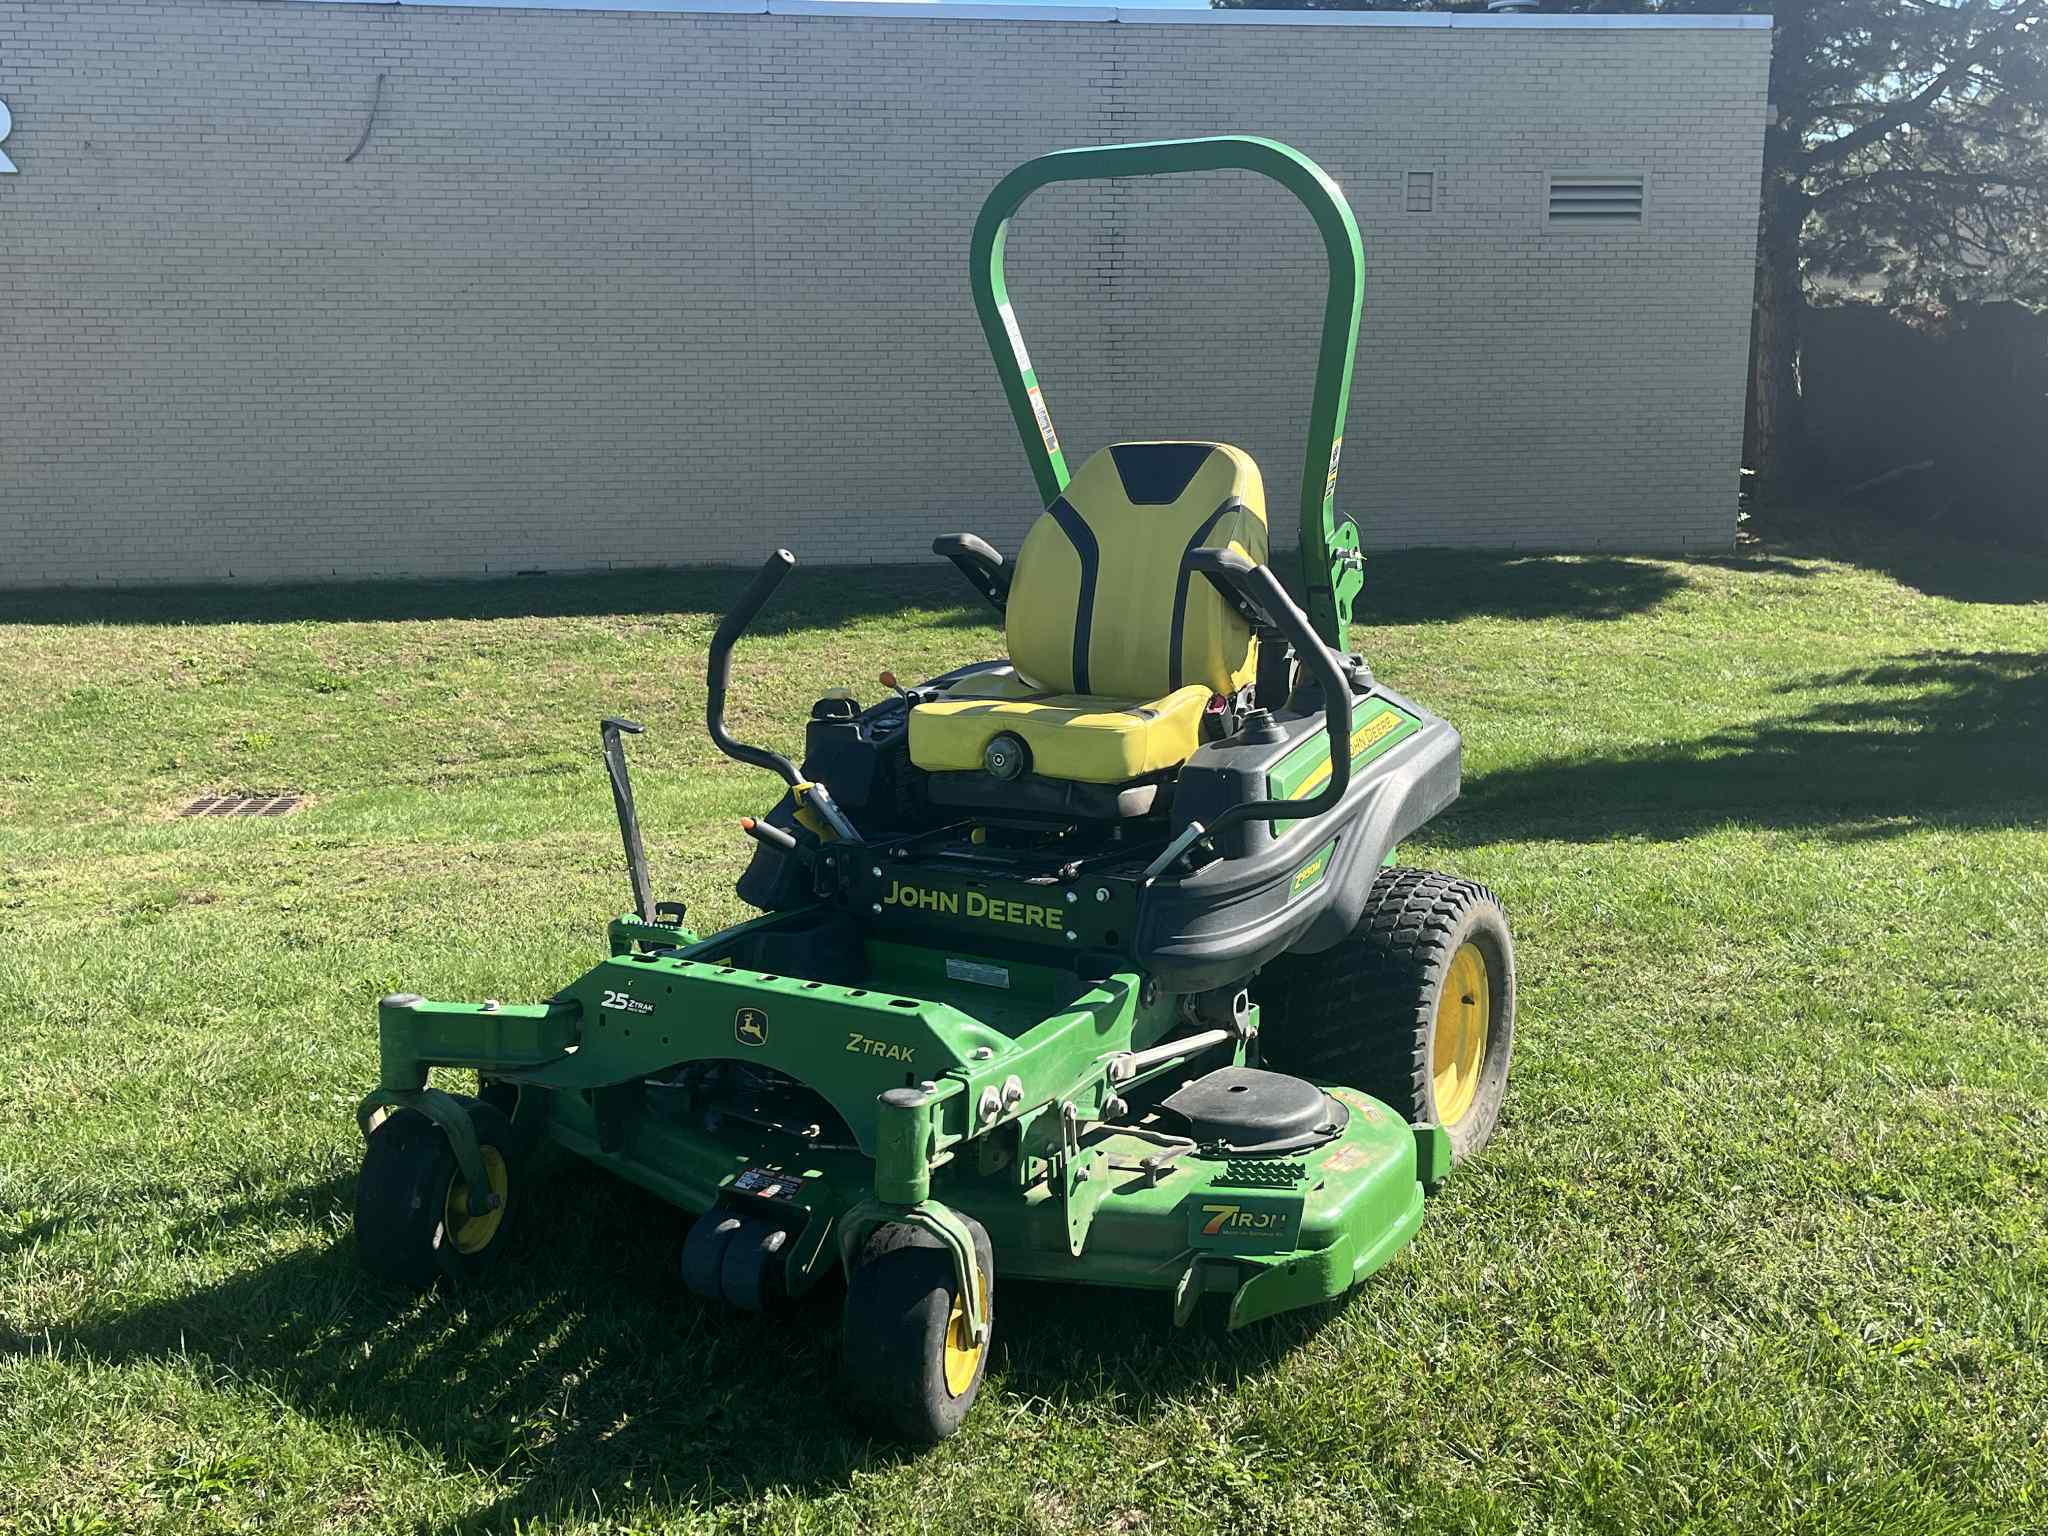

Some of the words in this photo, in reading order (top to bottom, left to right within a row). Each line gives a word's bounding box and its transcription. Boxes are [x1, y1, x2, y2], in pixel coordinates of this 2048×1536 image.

[1364, 716, 1393, 744] DEERE
[884, 880, 959, 914] JOHN
[966, 891, 1064, 930] DEERE
[600, 990, 630, 1010] 25
[628, 999, 654, 1012] ZTRAK
[846, 1032, 915, 1063] ZTRAK
